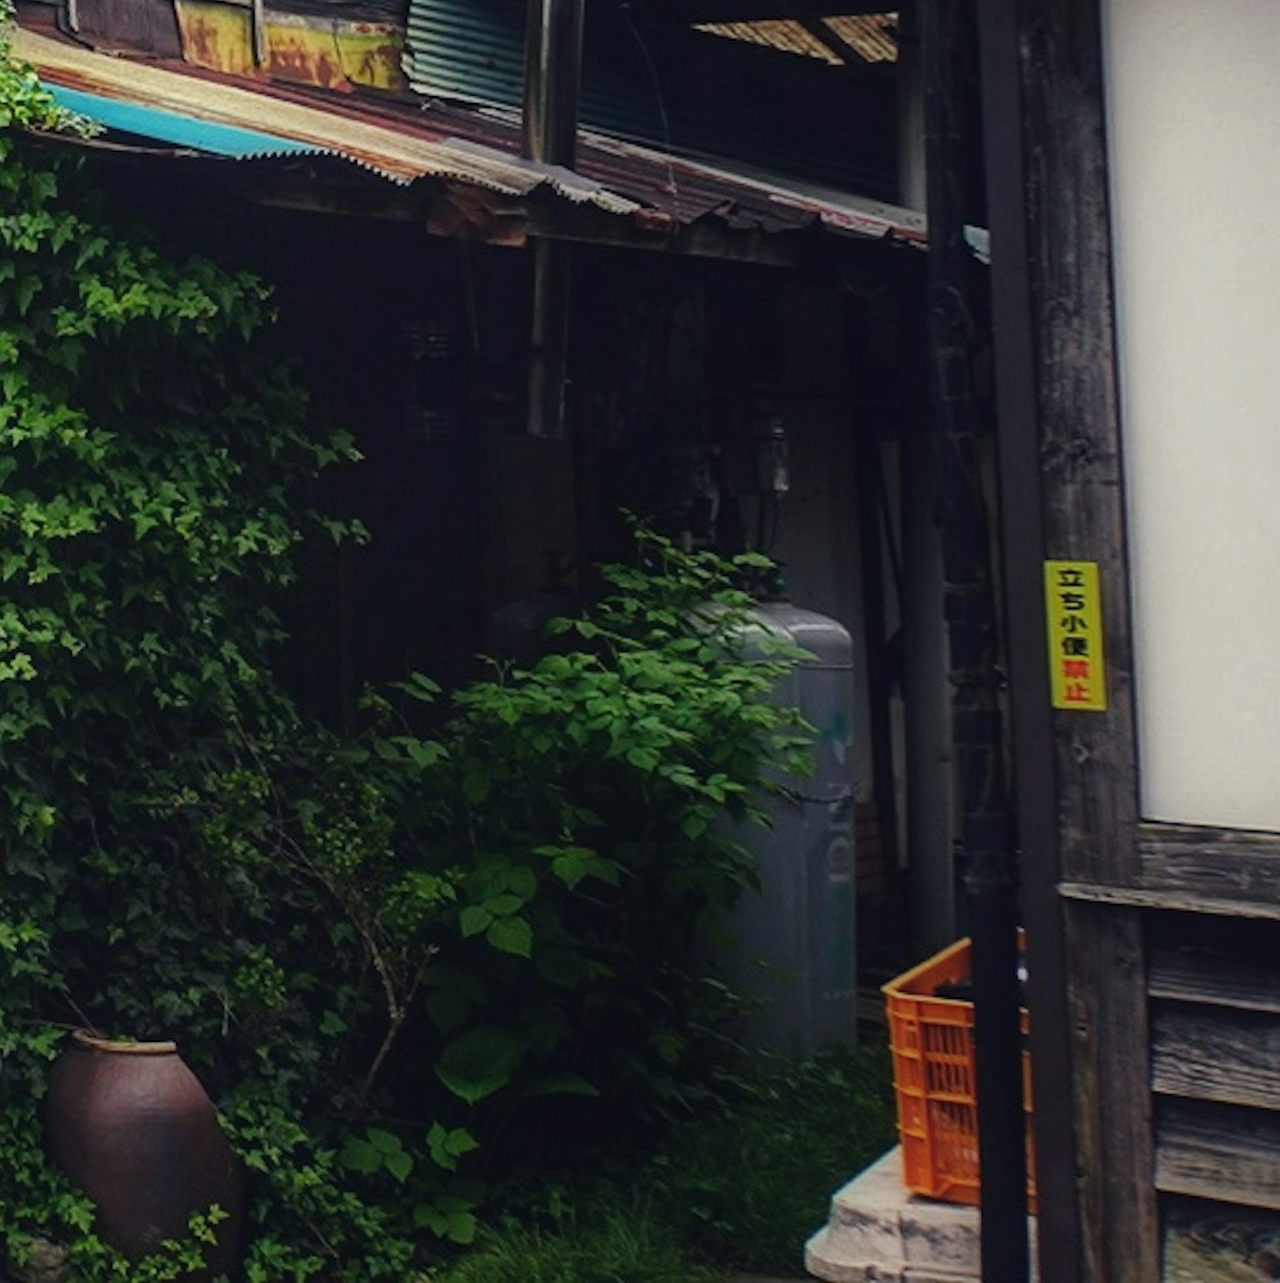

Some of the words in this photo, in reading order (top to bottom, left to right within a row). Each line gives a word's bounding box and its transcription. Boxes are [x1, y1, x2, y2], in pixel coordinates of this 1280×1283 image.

[1056, 569, 1091, 702] 立ち小便禁止
